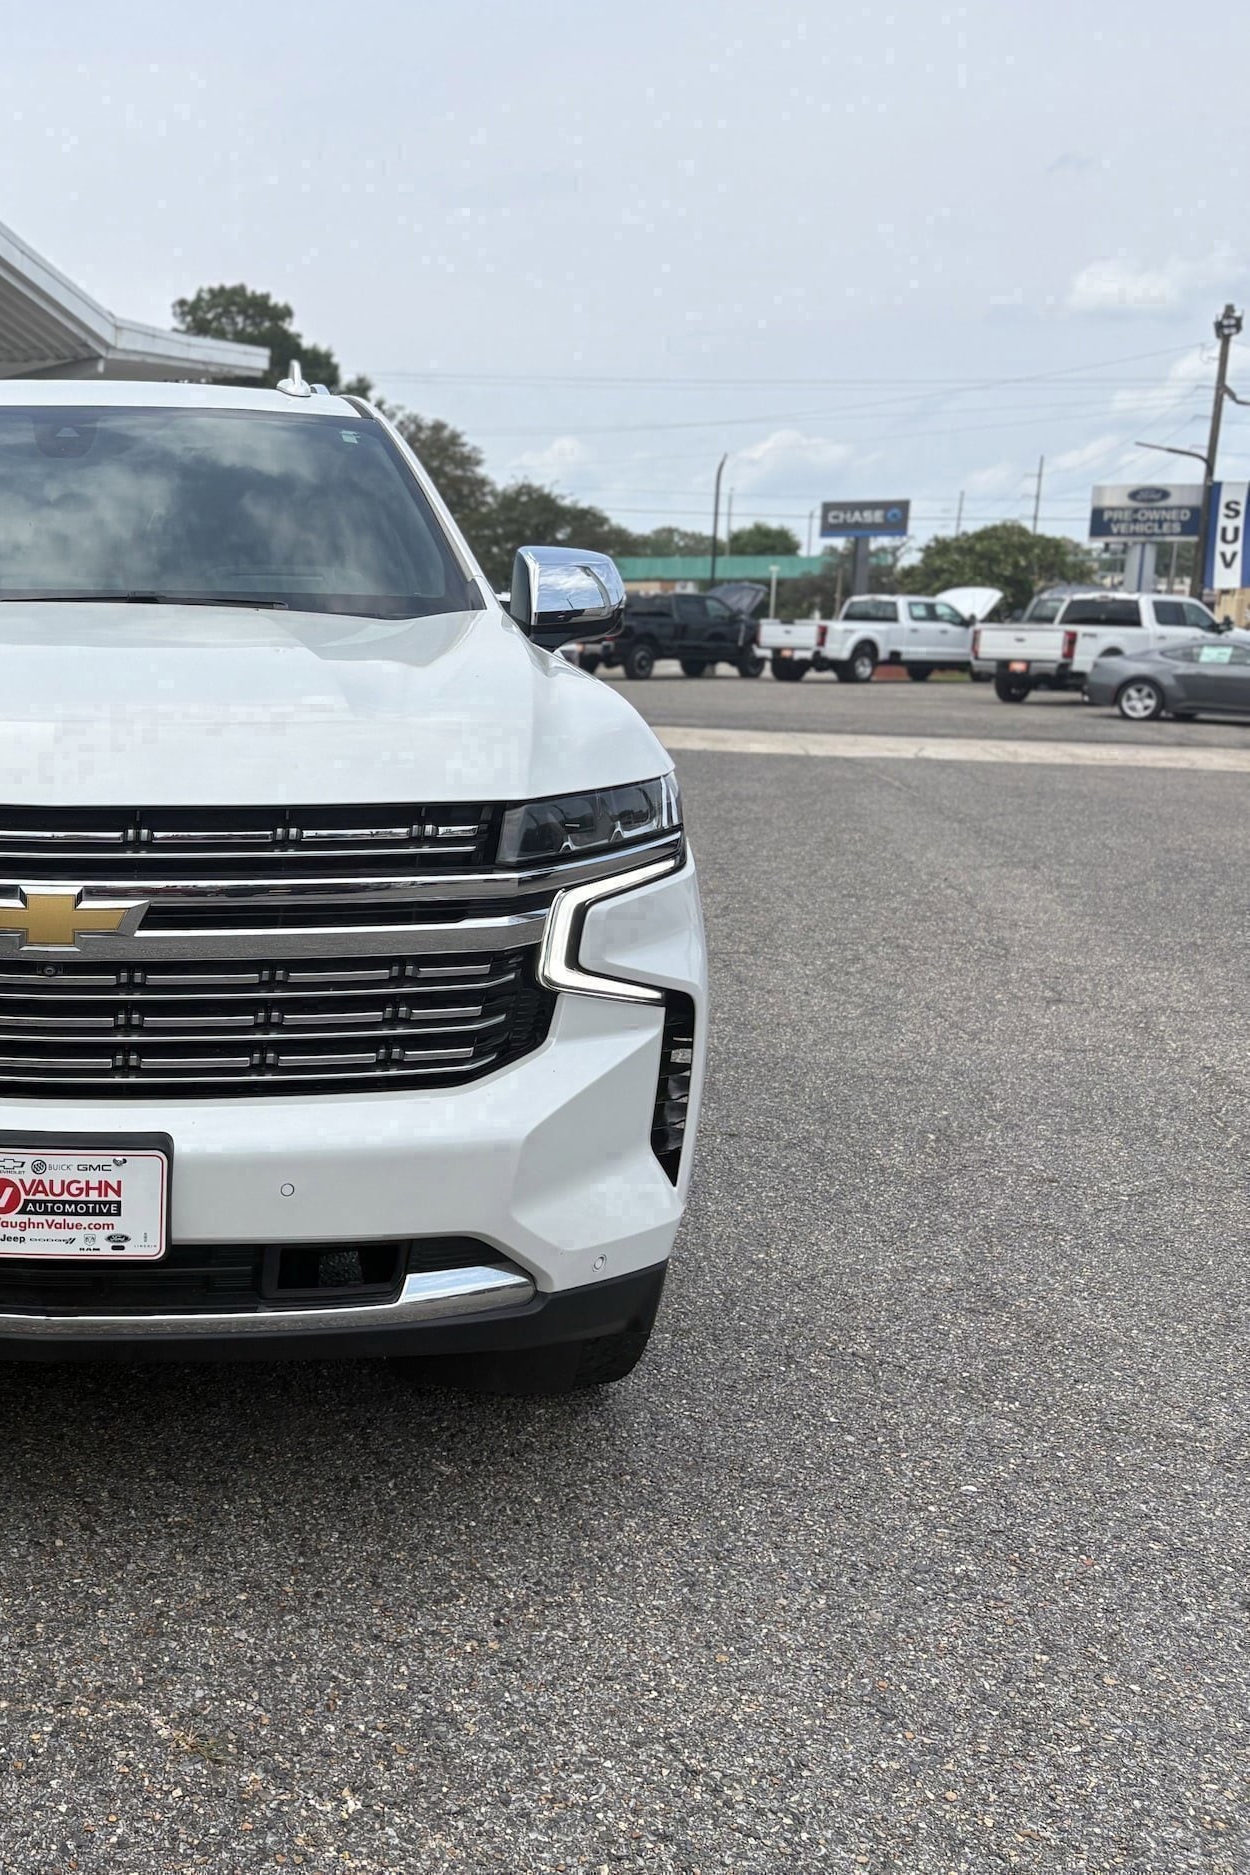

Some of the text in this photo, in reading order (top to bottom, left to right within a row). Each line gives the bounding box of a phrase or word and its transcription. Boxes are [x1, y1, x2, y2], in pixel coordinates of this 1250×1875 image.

[827, 509, 885, 524] CHASE
[1103, 508, 1191, 521] PRE-OWNED
[1110, 521, 1182, 534] VEHICLES
[1219, 500, 1242, 569] SUV
[48, 1163, 71, 1171] BUICK
[76, 1164, 112, 1172] GMC
[18, 1178, 122, 1198] VAUGHN
[26, 1202, 118, 1214] AUTOMOTIVE
[0, 1233, 26, 1243] Jeep
